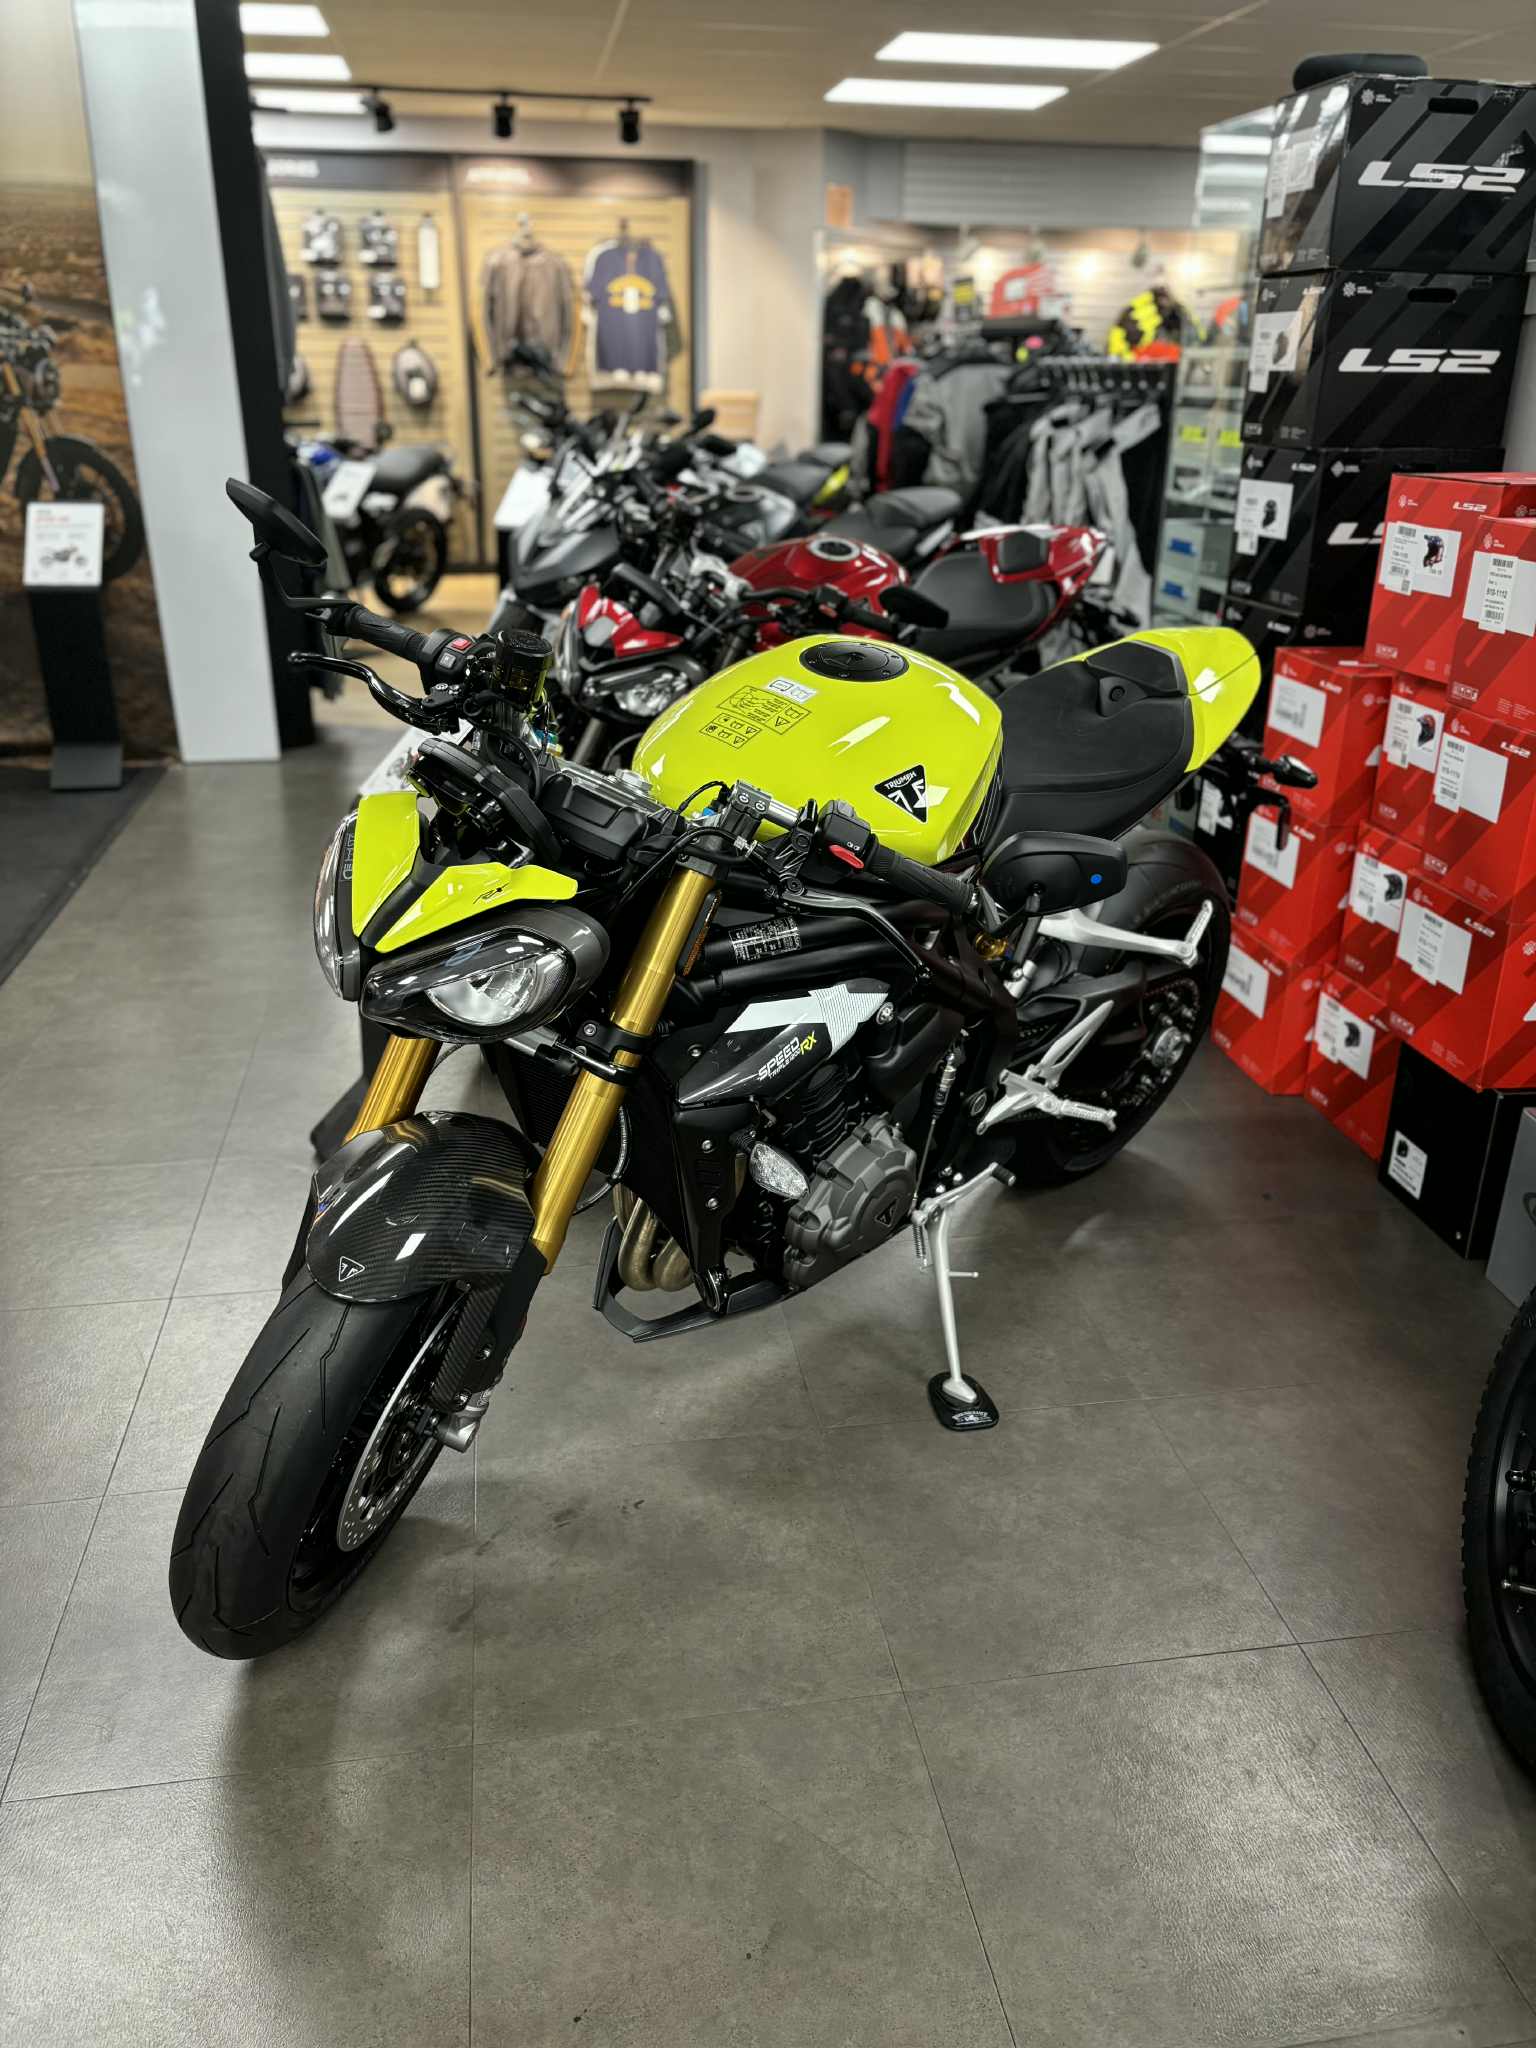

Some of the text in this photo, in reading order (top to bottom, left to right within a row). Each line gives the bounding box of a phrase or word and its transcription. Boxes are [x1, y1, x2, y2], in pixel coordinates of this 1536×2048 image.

[1358, 160, 1526, 193] LS2
[1338, 348, 1501, 374] LS2
[1452, 501, 1488, 513] LS2
[1500, 741, 1531, 759] LS2
[884, 771, 917, 790] TRIUMPH
[799, 1030, 817, 1056] RX
[757, 1036, 800, 1081] SPEED
